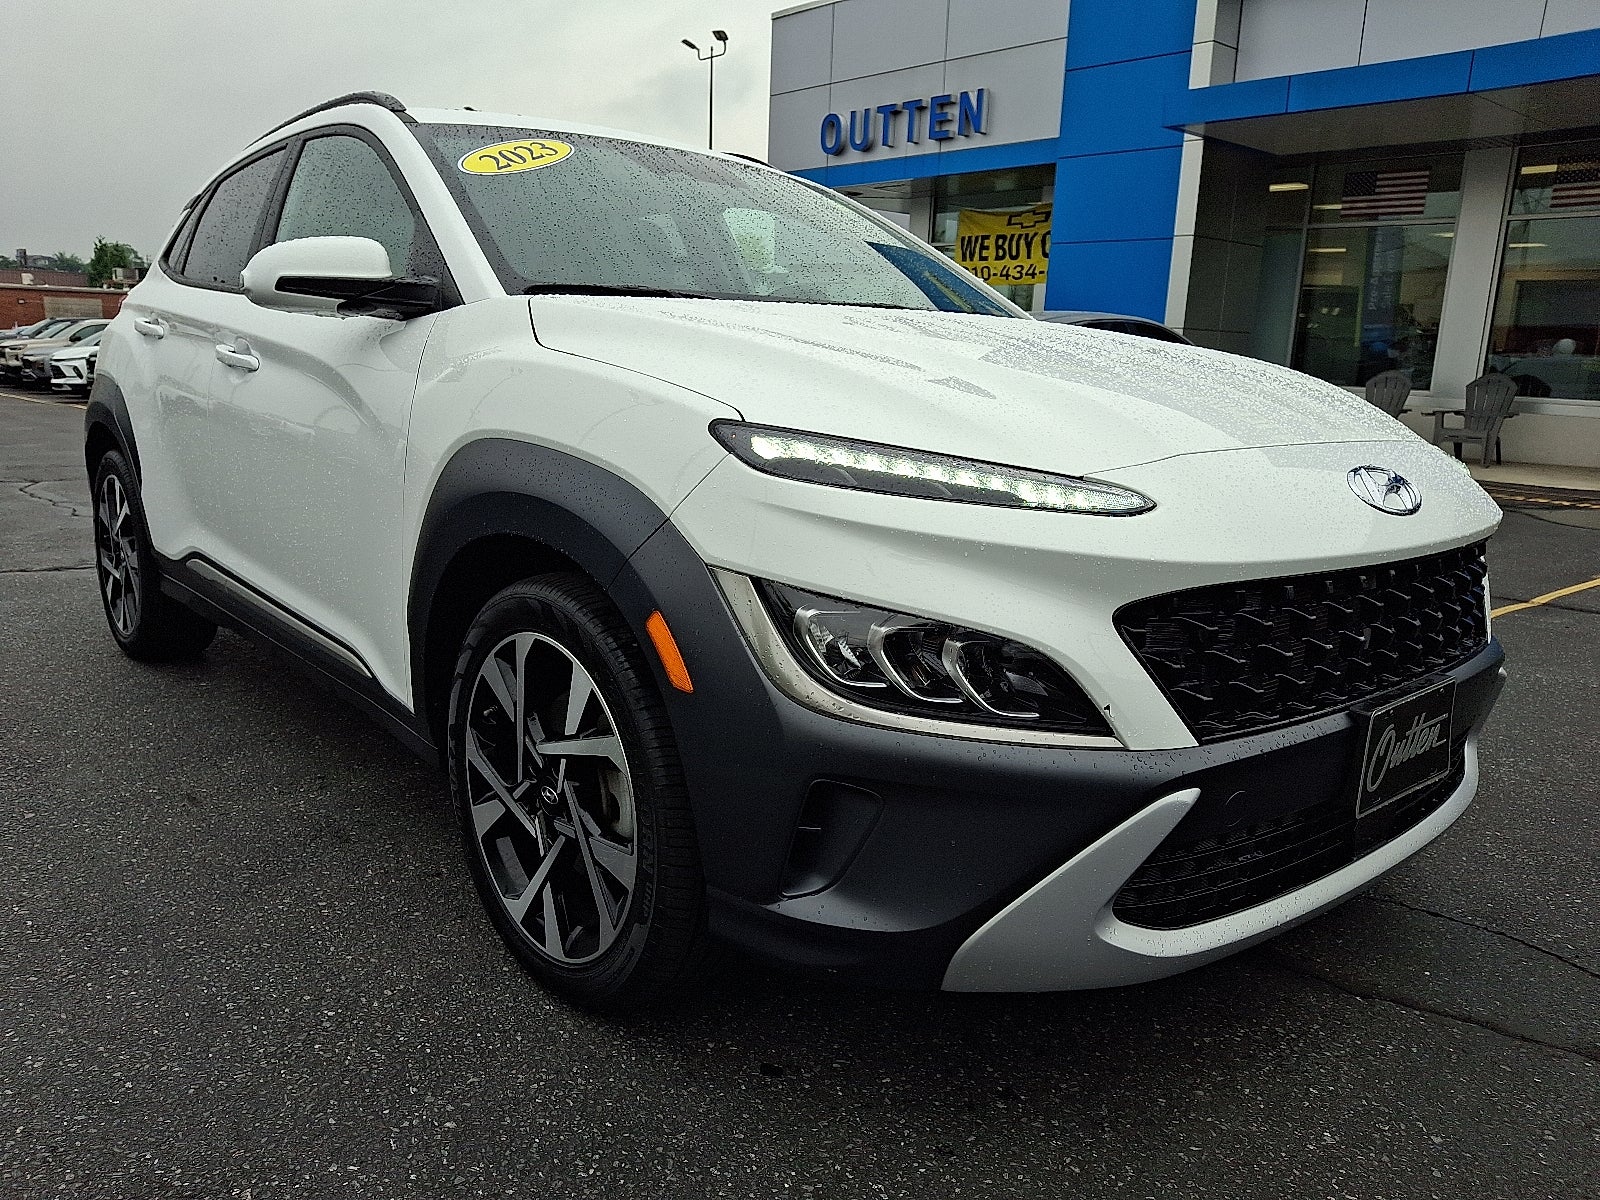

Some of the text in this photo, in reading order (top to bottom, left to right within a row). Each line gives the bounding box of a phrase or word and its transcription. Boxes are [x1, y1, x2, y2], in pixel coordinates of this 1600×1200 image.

[820, 88, 988, 156] OUTTEN
[479, 142, 559, 170] 2023
[961, 234, 991, 262] WE
[994, 232, 1039, 261] BUY
[962, 264, 1045, 281] 10-434-
[1366, 712, 1449, 793] Outten
